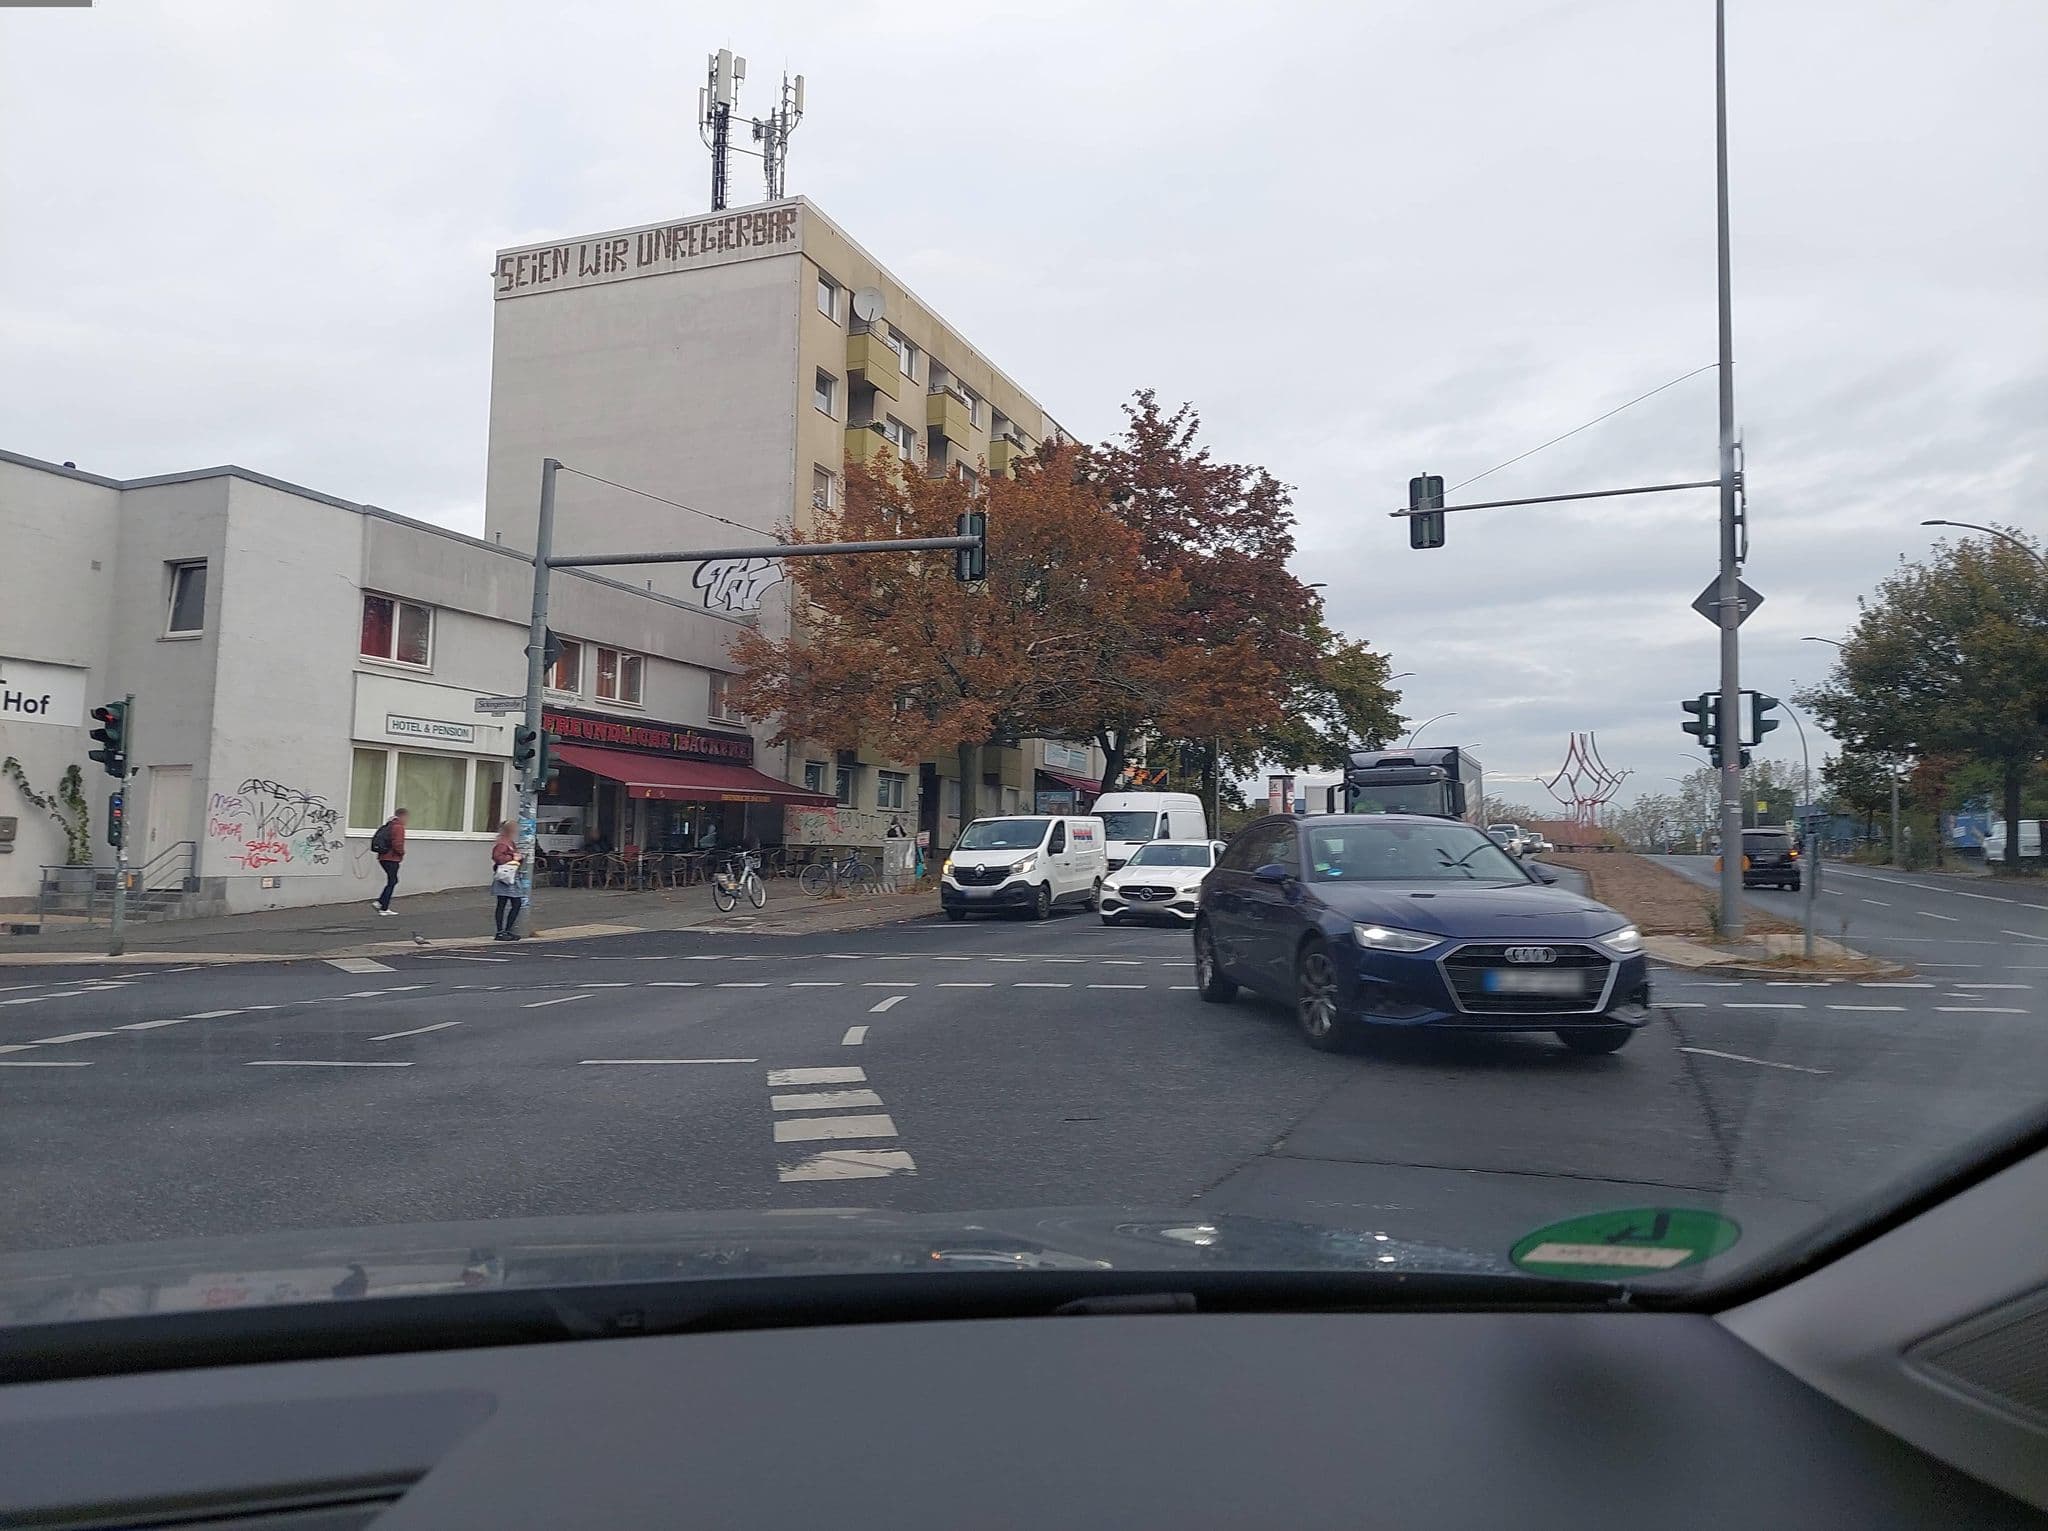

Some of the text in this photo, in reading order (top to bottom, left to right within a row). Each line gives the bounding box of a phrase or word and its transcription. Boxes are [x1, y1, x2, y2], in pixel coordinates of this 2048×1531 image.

[3, 690, 51, 715] Hof
[393, 720, 470, 737] HOTEL & PENSION
